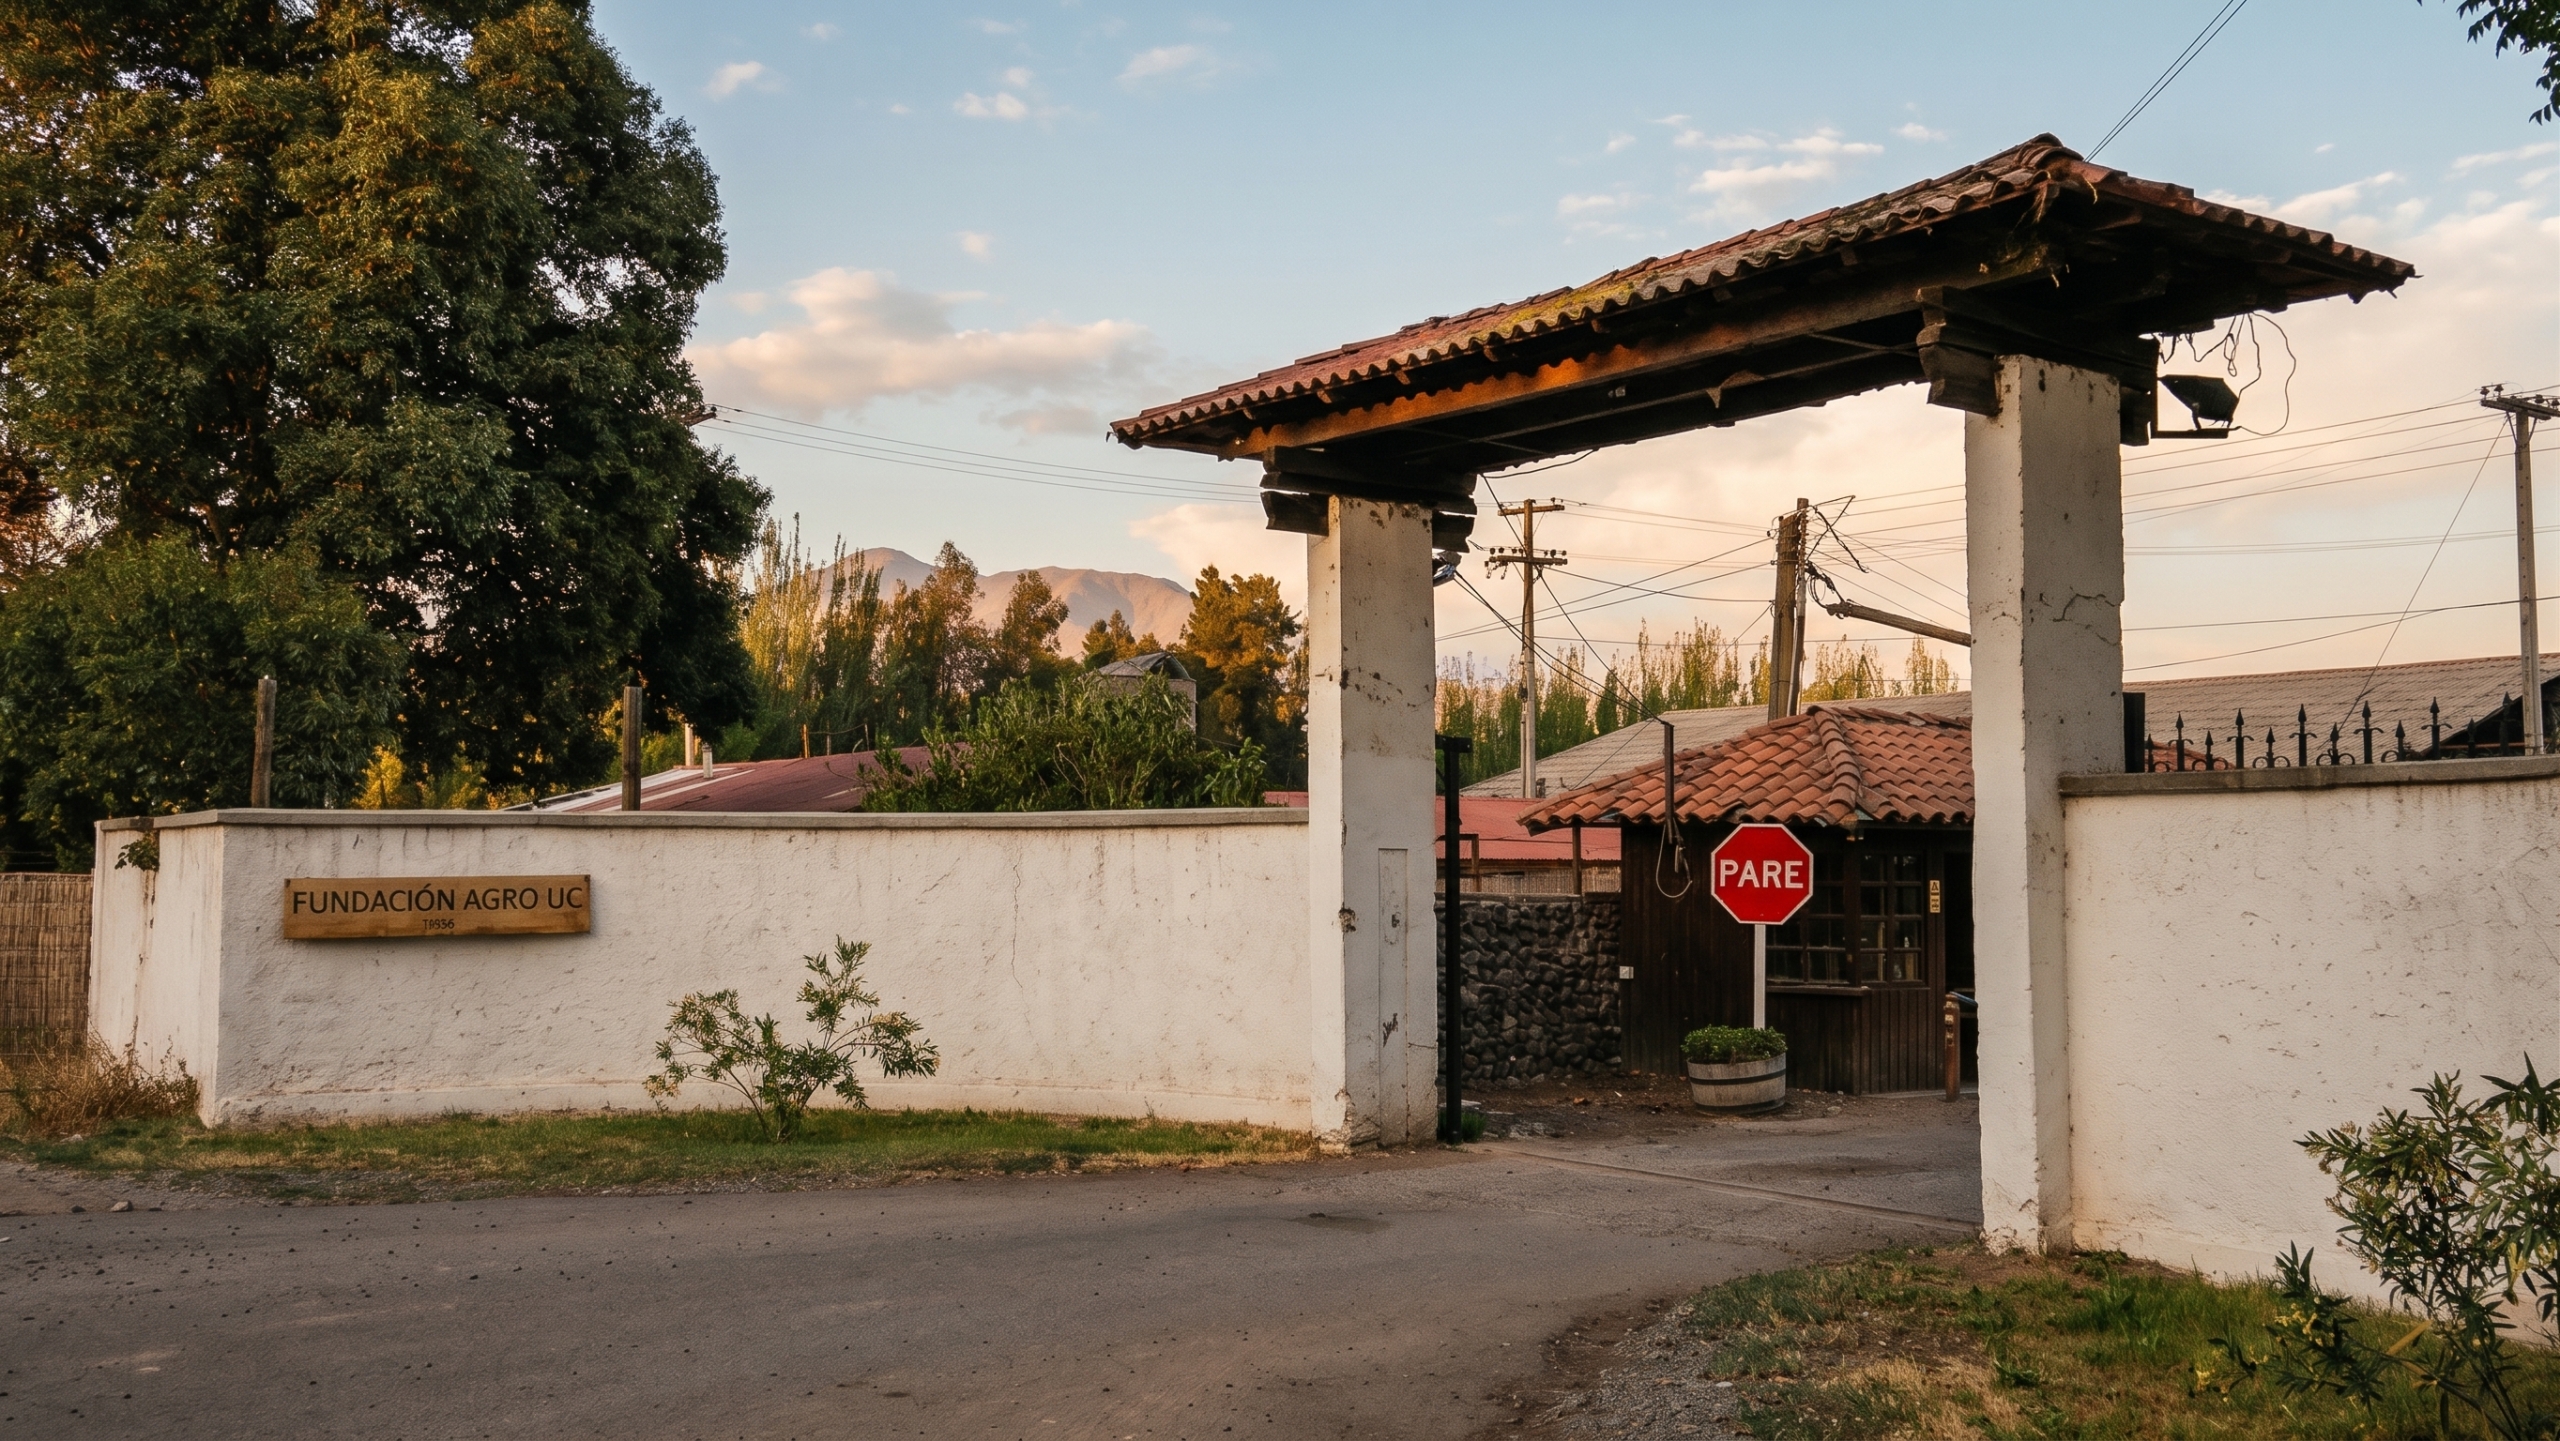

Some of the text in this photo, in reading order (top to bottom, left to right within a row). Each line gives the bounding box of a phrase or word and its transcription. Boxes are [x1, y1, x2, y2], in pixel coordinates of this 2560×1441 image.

[1720, 859, 1803, 888] PARE
[293, 883, 582, 914] FUNDACIÓN AGRO UC
